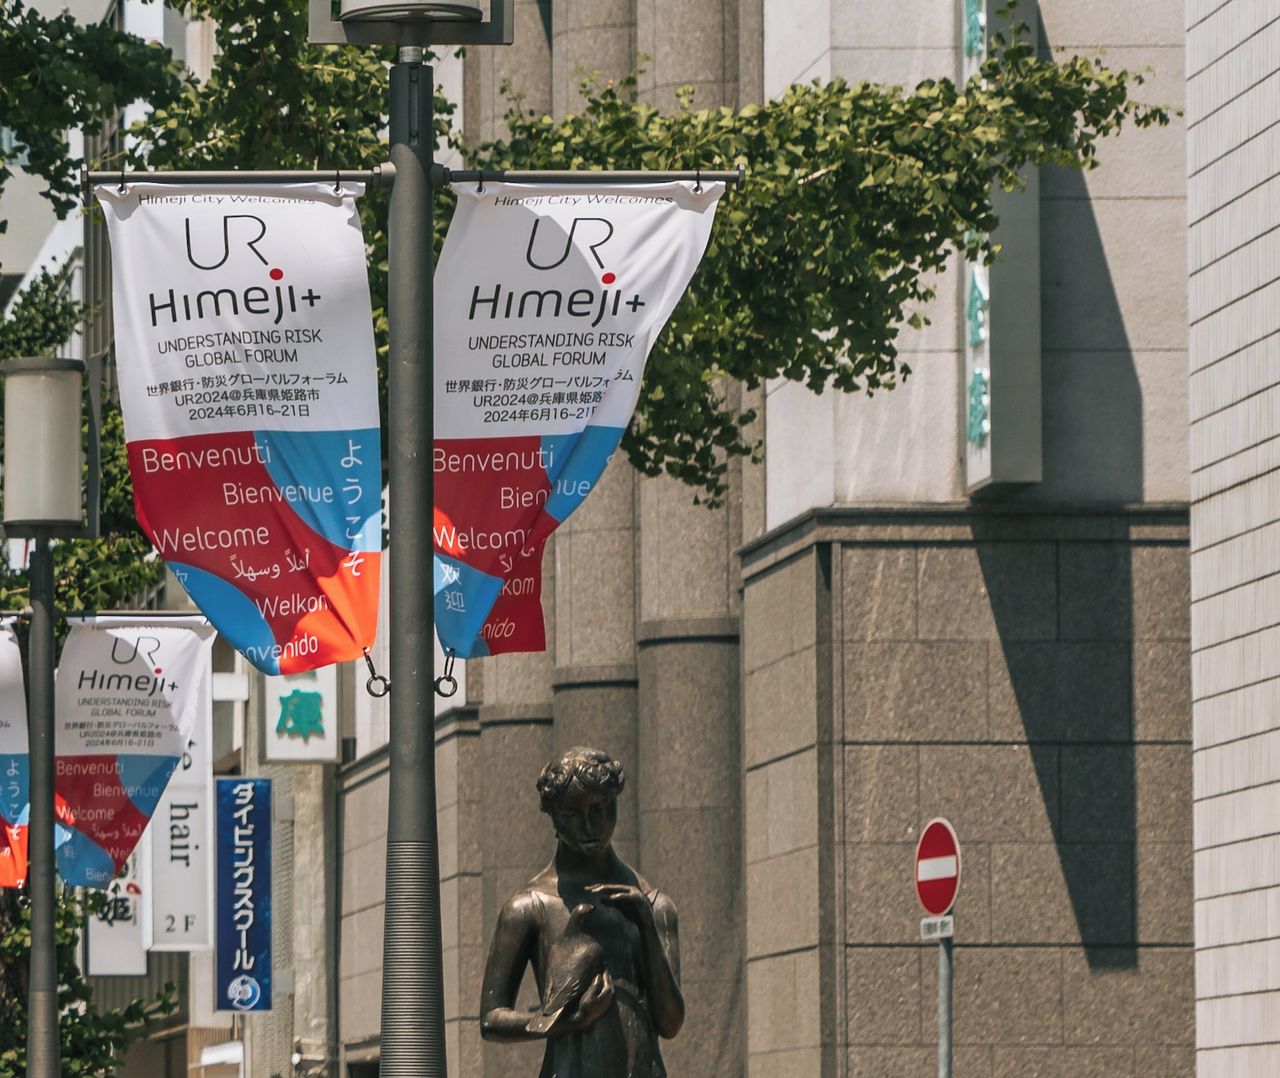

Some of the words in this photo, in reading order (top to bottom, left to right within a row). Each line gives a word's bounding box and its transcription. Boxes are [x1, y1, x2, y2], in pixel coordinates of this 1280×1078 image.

[549, 196, 582, 206] City
[186, 214, 268, 270] UR
[526, 218, 614, 270] UR
[149, 272, 321, 326] Himeji+
[468, 275, 645, 327] Himeji+
[158, 330, 281, 355] UNDERSTANDING
[285, 328, 322, 344] RISK
[468, 333, 594, 350] UNDERSTANDING
[598, 333, 636, 348] RISK
[185, 350, 240, 368] GLOBAL
[245, 349, 298, 363] FORUM
[492, 353, 548, 368] GLOBAL
[553, 352, 606, 366] FORUM
[146, 372, 348, 397] 世界銀行・防災グローバルフォーラム
[174, 388, 320, 406] UR2024@兵庫県姫路市
[142, 440, 272, 473] Benvenuti
[434, 444, 554, 472] Benvenuti
[222, 483, 333, 506] Bienvenue
[340, 440, 364, 576] ようこそ
[152, 526, 270, 553] Welcome
[78, 670, 178, 696] Himeji+
[78, 698, 150, 708] UNDERSTANDING
[92, 707, 123, 716] GLOBAL
[126, 708, 156, 716] FORUM
[56, 760, 124, 776] Benvenuti
[94, 783, 159, 797] Bienvenue
[58, 806, 115, 821] Welcome
[170, 802, 198, 867] hair
[232, 782, 255, 971] ダイビングスクール
